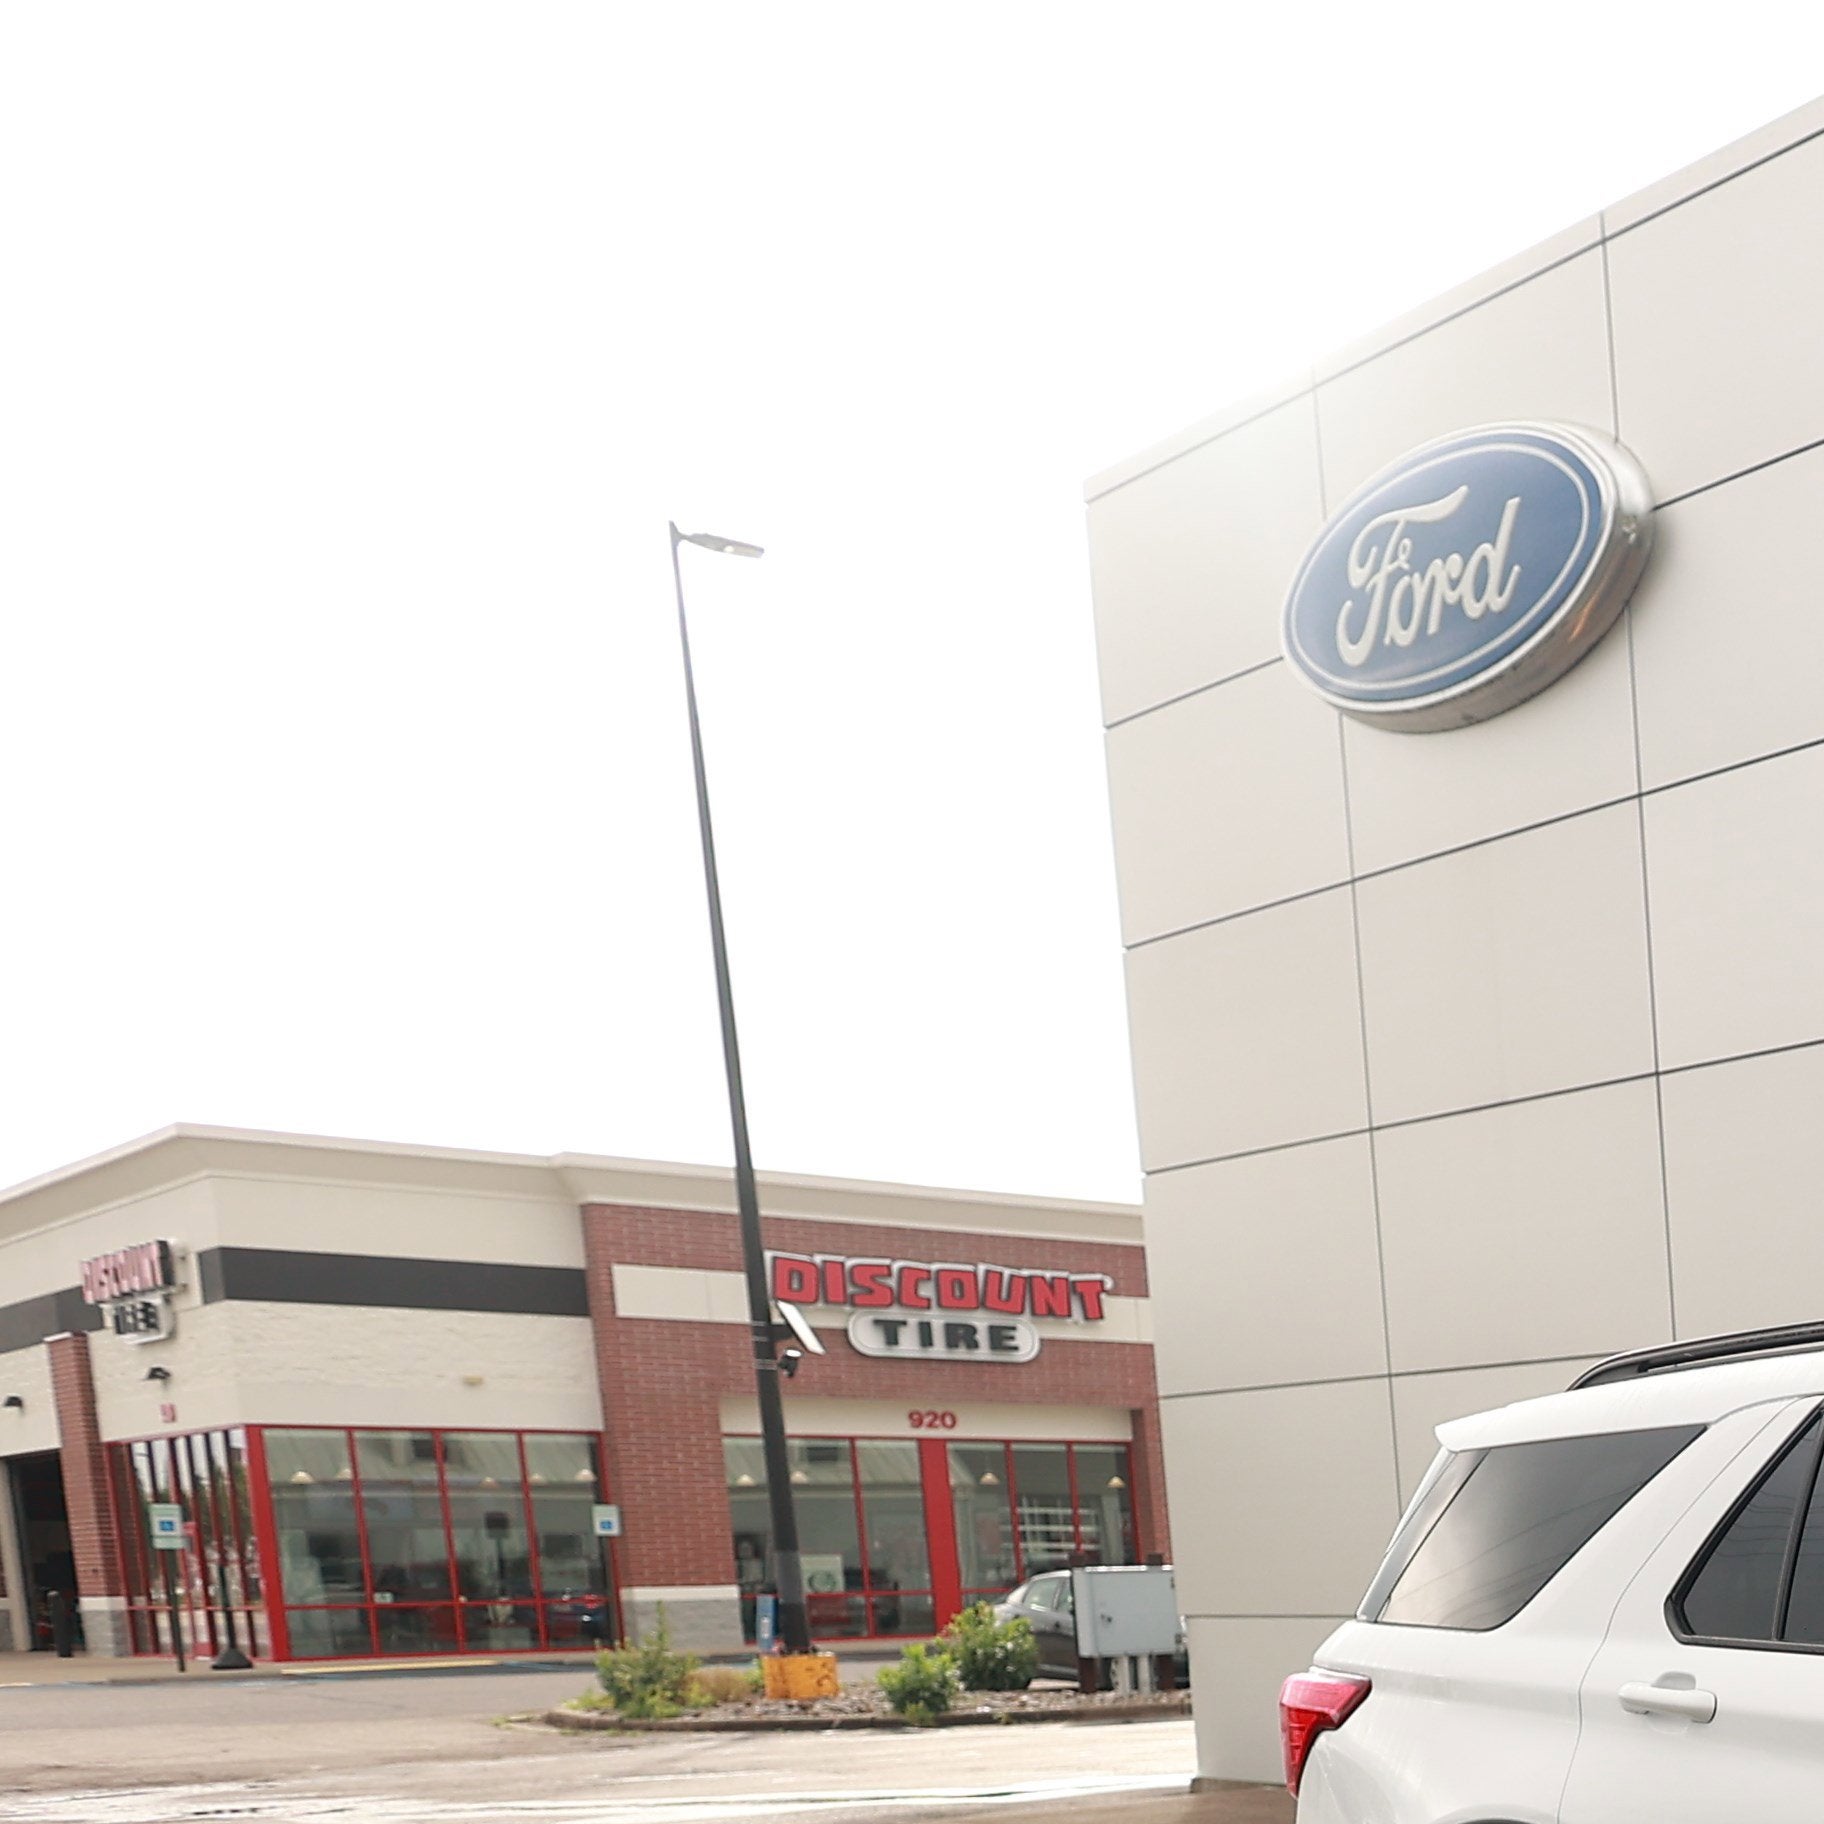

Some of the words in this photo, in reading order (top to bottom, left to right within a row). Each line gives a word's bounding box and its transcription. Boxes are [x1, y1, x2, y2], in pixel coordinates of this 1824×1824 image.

[1335, 485, 1521, 667] Ford
[765, 1252, 1107, 1321] DISCOUNT
[873, 1318, 1020, 1353] TIRE
[908, 1410, 958, 1430] 920
